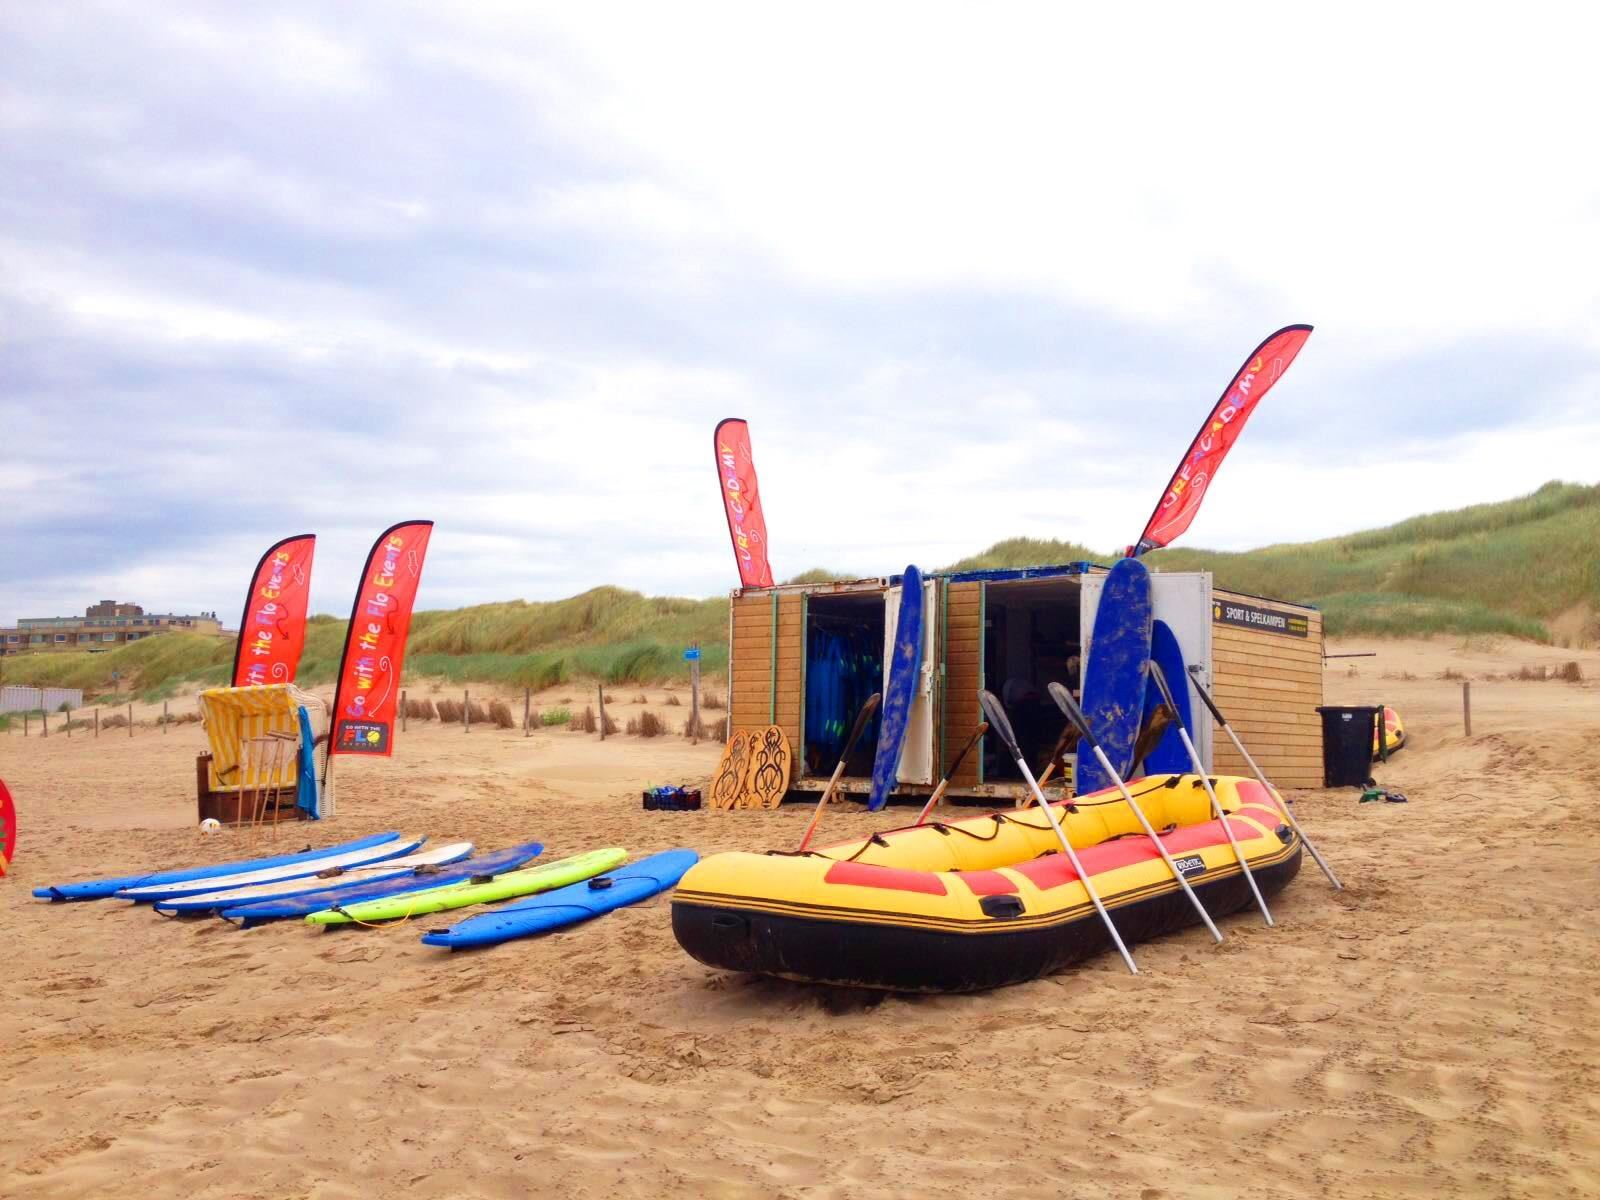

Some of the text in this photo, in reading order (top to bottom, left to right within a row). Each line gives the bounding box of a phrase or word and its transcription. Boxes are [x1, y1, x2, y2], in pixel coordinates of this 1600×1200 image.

[1160, 465, 1192, 514] URF
[373, 534, 404, 589] Events
[245, 551, 290, 686] ith the Flo Events
[366, 593, 389, 618] Flo
[1226, 607, 1244, 619] SPORT
[1245, 610, 1250, 622] &
[1250, 611, 1286, 628] SPELKAMPEN
[359, 623, 382, 651] the
[353, 656, 374, 690] with
[347, 696, 366, 718] Go
[343, 729, 381, 743] FLO
